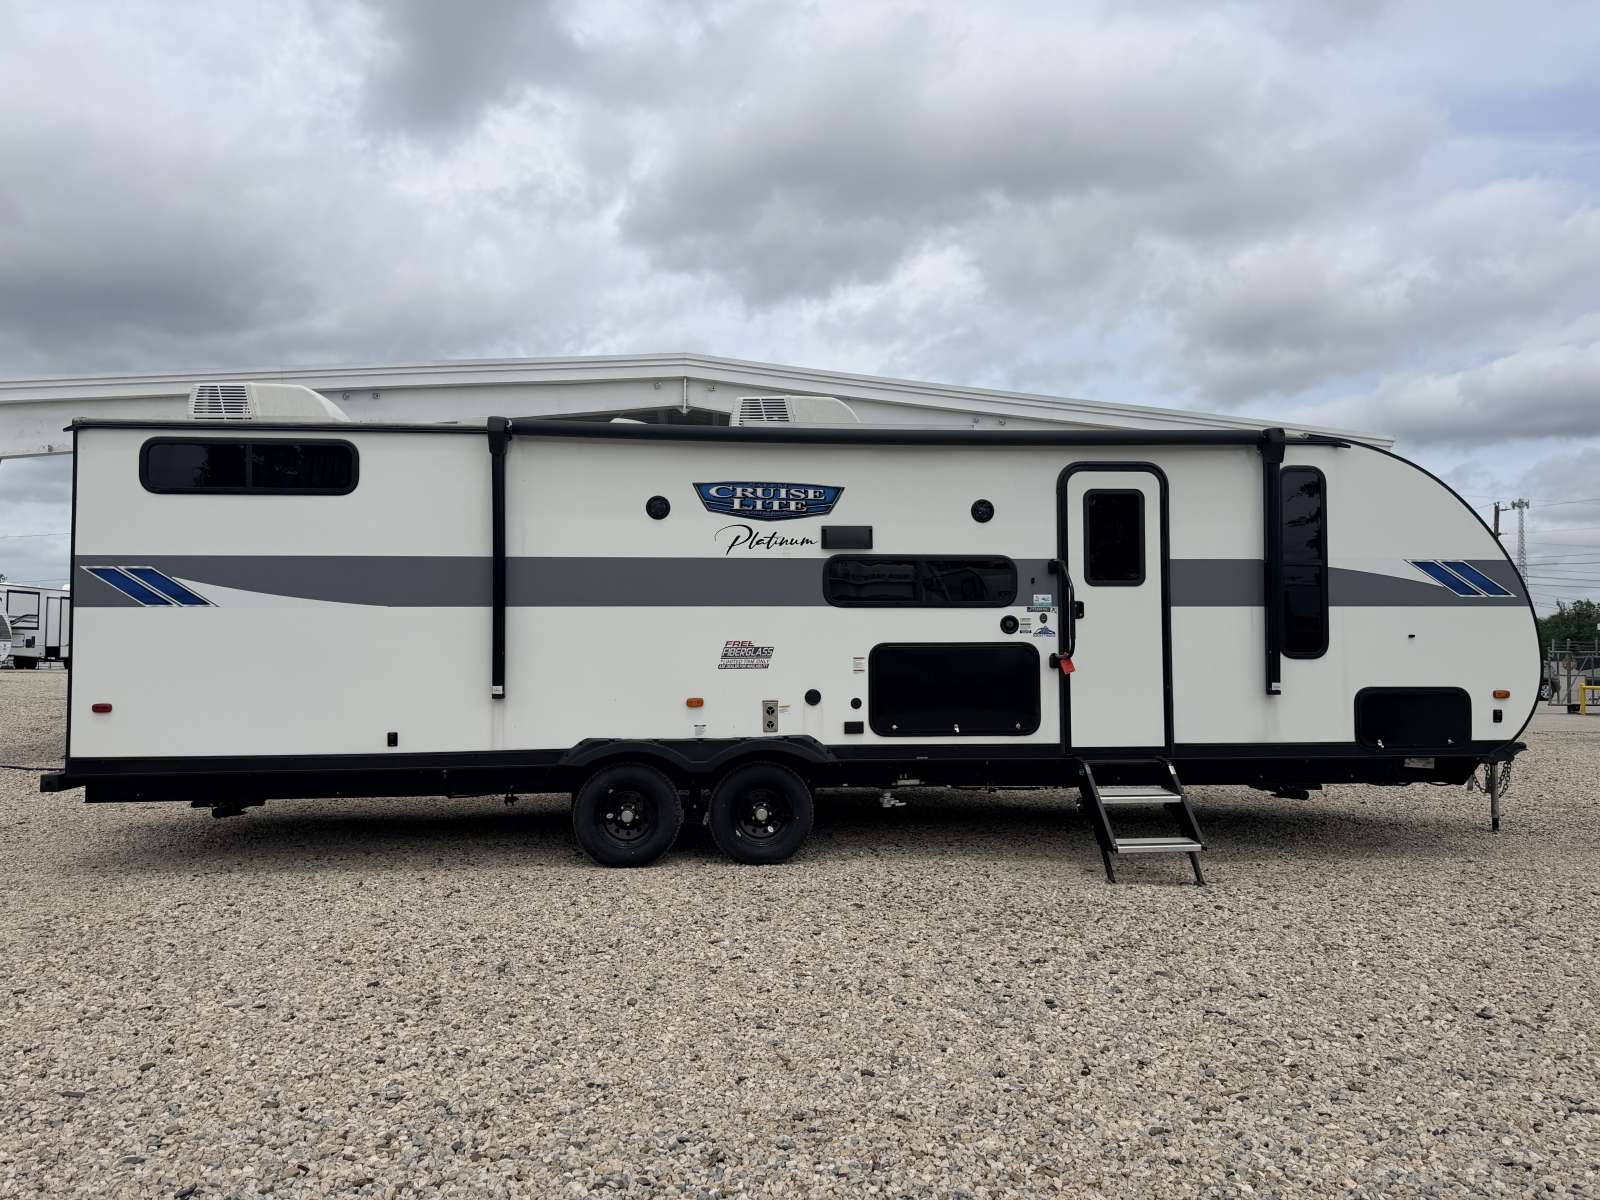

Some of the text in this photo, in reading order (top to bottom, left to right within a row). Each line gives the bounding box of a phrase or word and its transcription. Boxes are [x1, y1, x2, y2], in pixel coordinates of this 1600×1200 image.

[709, 485, 825, 500] CRUISE
[732, 498, 807, 512] LITE
[714, 524, 817, 556] Platinum
[722, 647, 773, 657] FIBERGLASS
